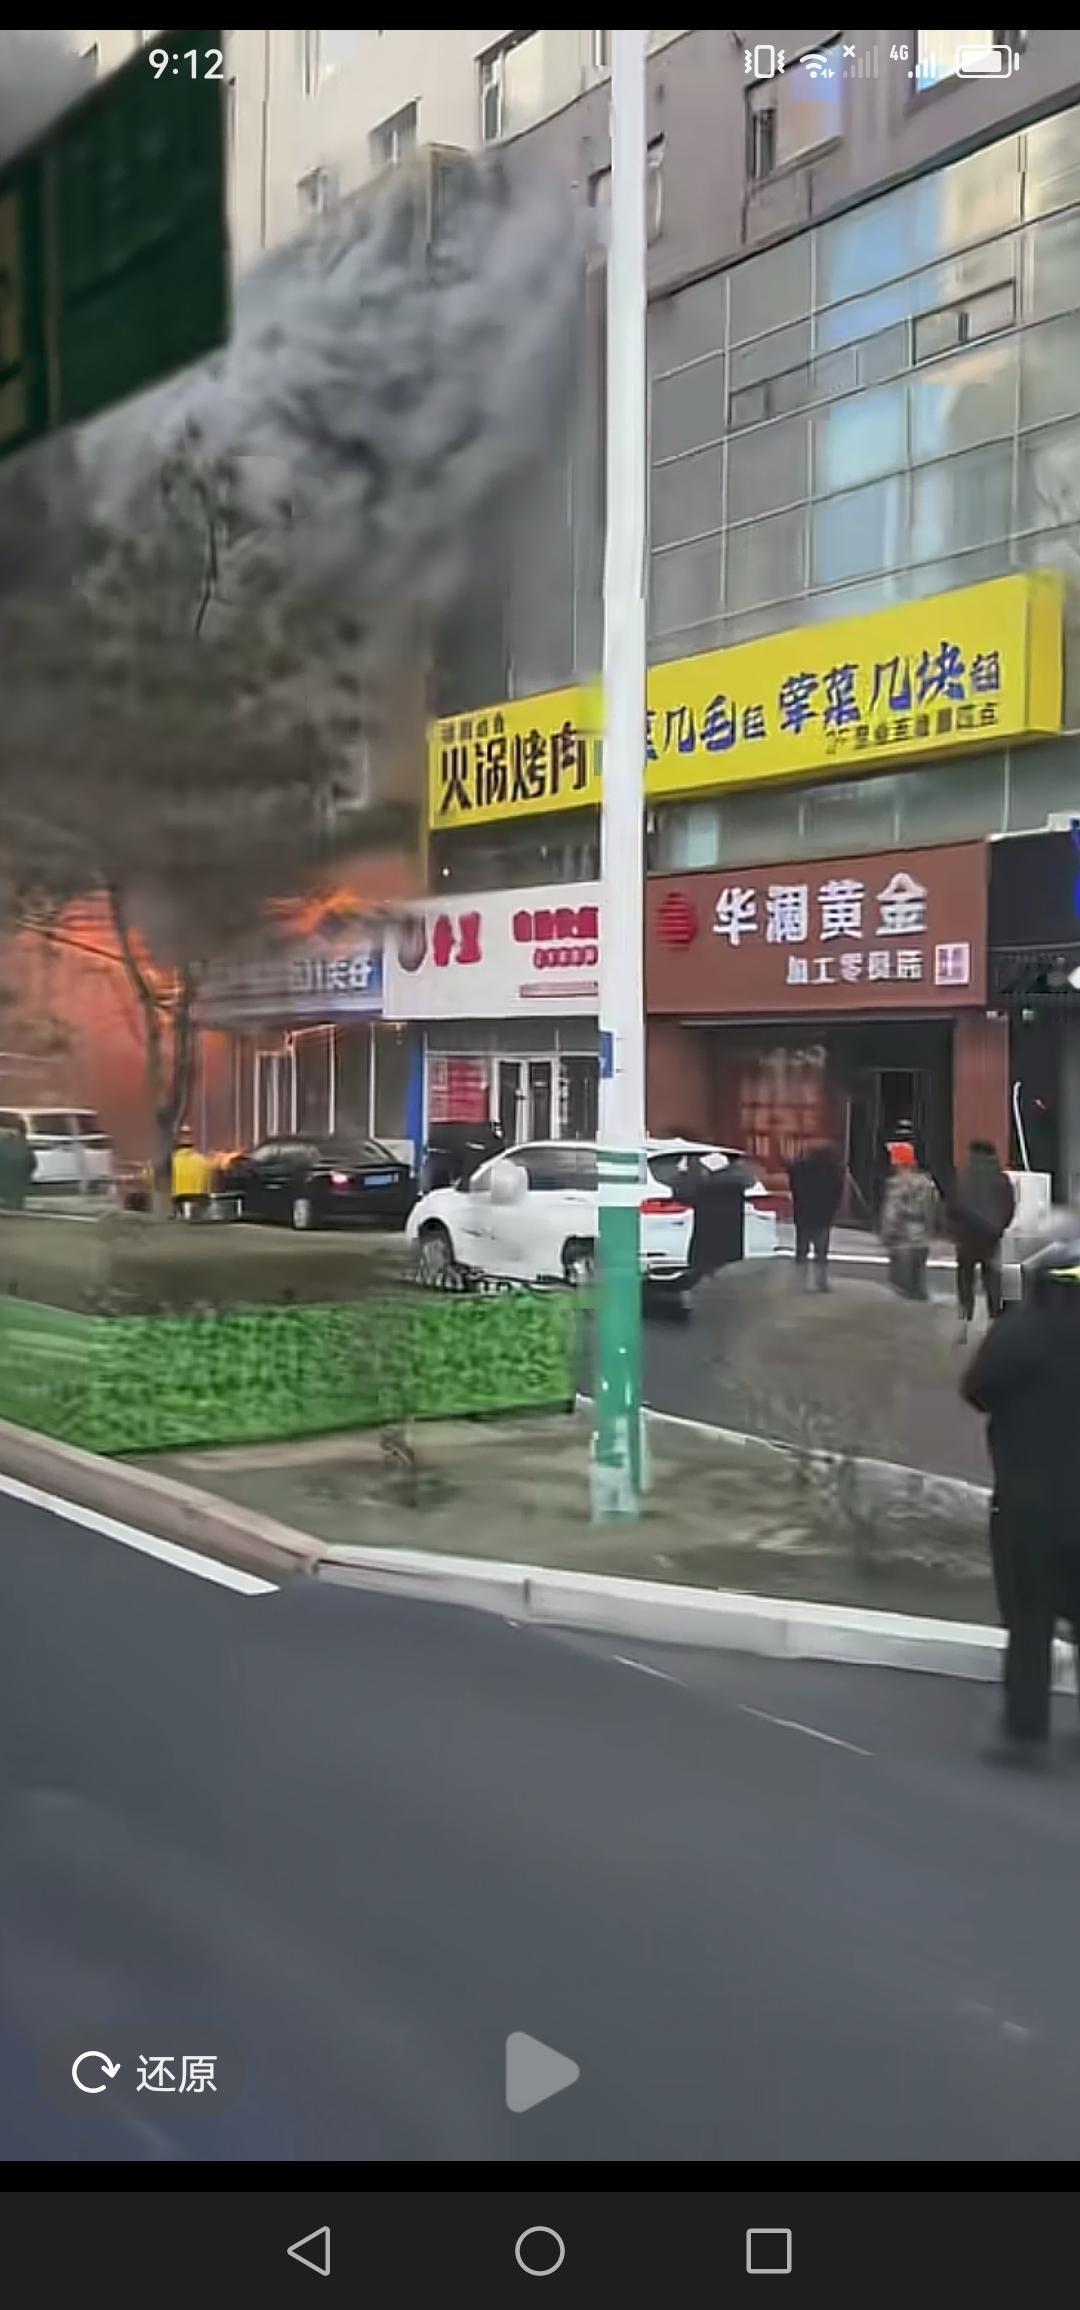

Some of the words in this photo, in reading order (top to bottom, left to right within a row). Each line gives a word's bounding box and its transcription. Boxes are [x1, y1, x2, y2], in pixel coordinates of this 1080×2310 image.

[439, 720, 586, 816] 火锅烤肉
[712, 872, 928, 946] 华澜黄金
